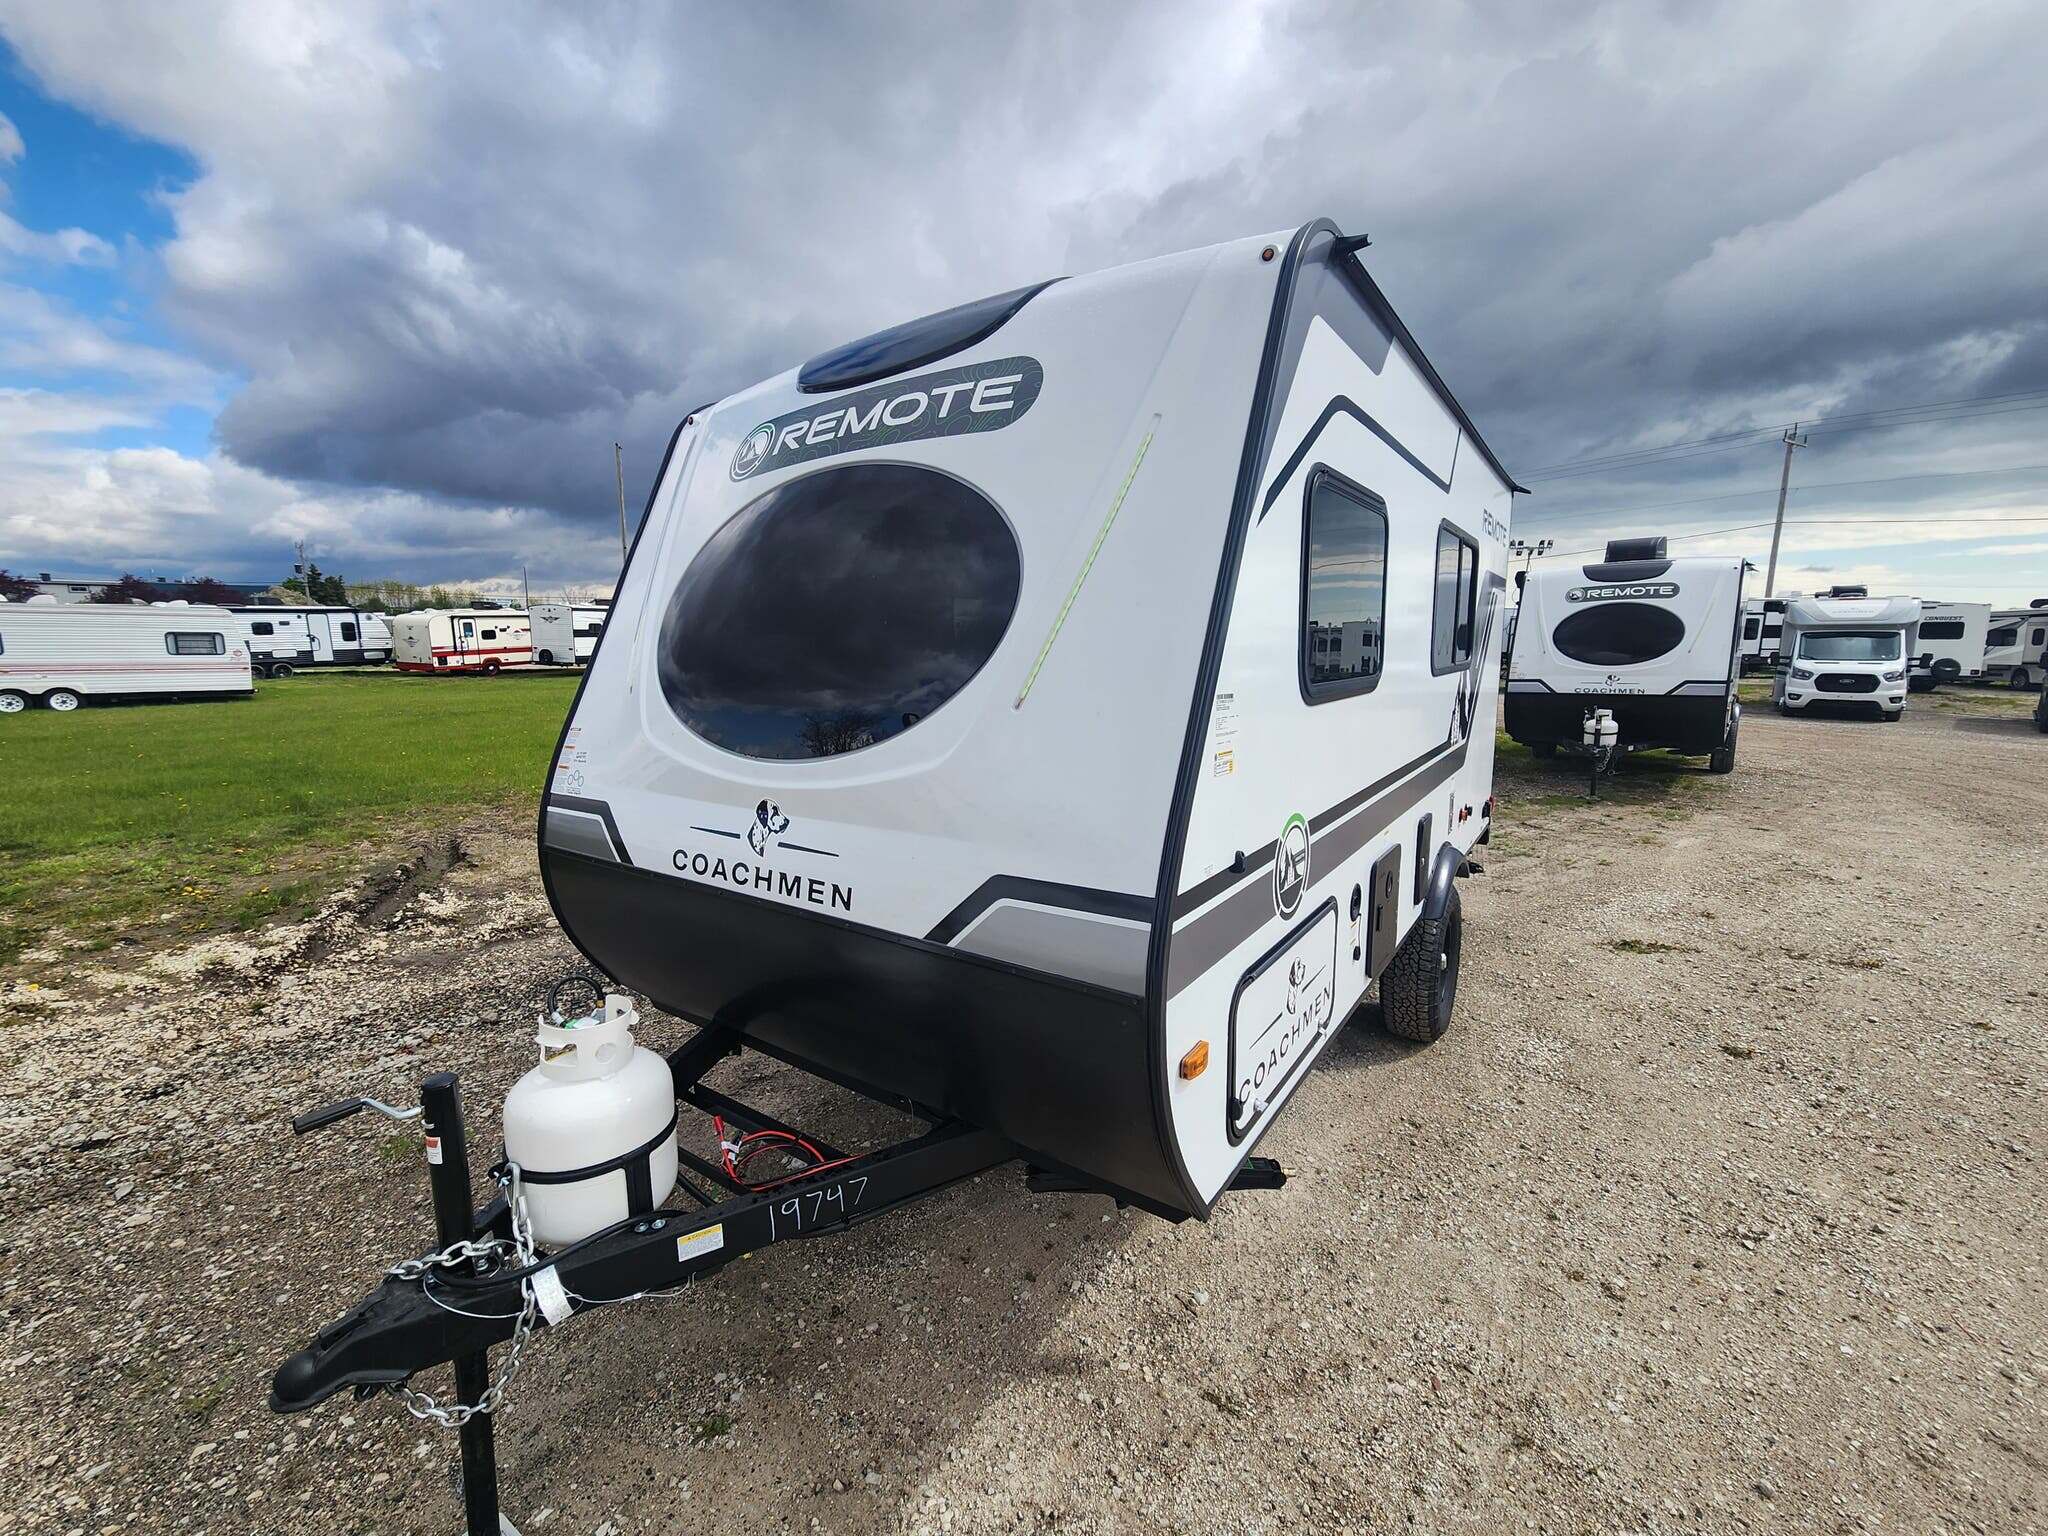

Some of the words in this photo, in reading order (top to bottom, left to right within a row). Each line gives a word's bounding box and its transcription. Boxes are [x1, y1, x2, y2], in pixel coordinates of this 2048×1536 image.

[772, 373, 1023, 456] REMOTE
[1482, 508, 1508, 548] REMOTE
[1586, 585, 1675, 599] REMOTE
[1574, 687, 1646, 695] COACHMEN
[672, 848, 853, 911] COACHMEN
[1239, 980, 1331, 1106] COACHMEN
[769, 1176, 868, 1242] 19747
